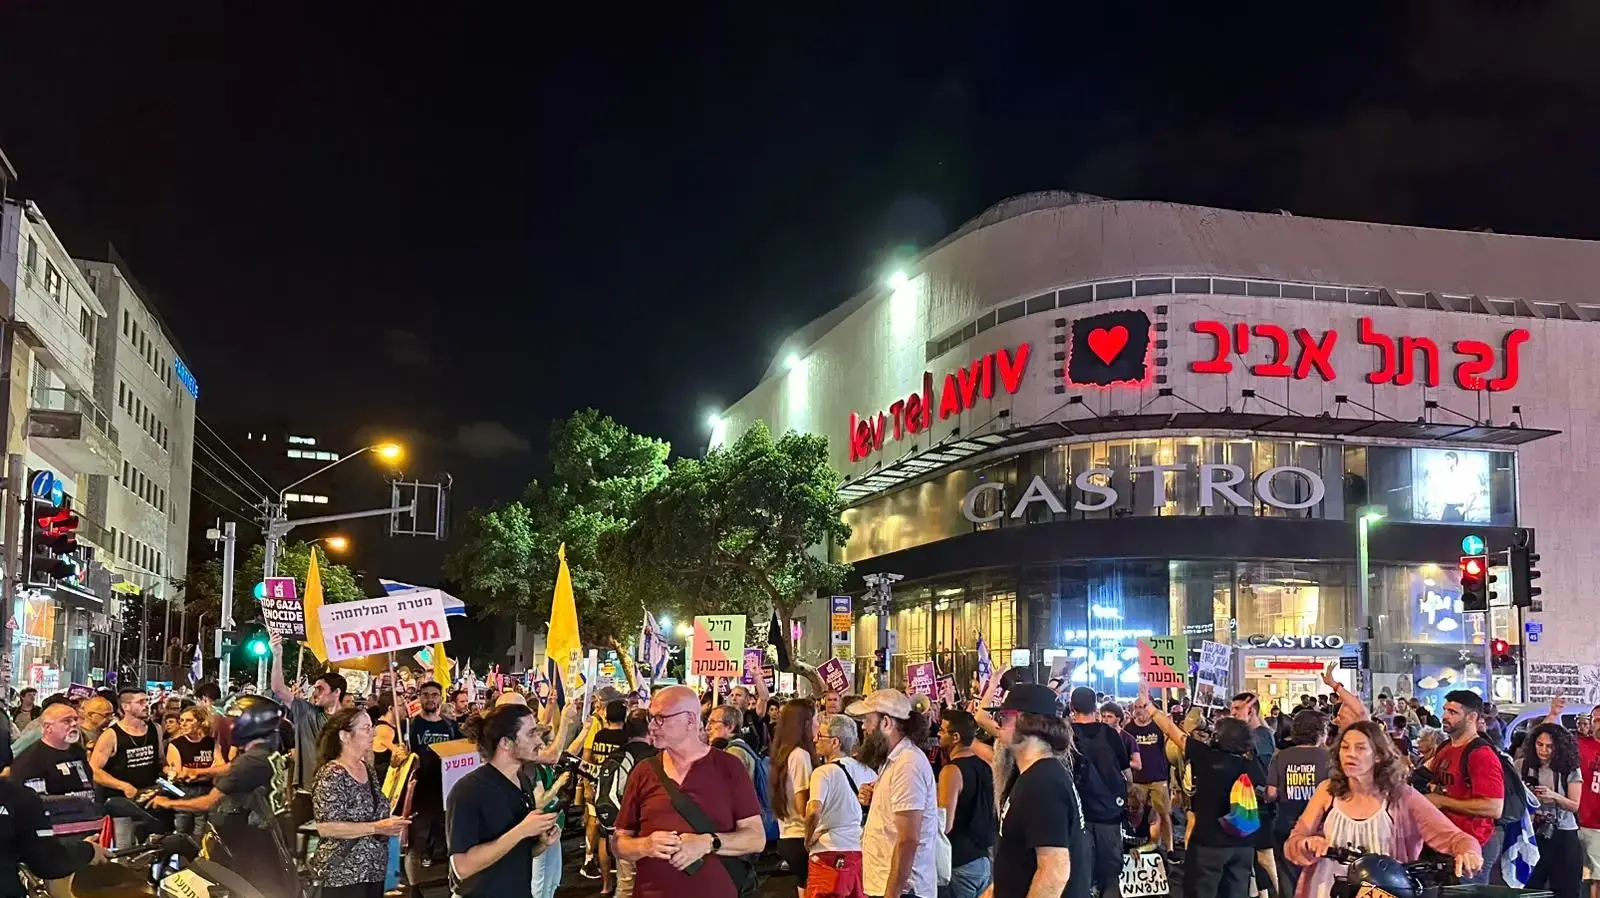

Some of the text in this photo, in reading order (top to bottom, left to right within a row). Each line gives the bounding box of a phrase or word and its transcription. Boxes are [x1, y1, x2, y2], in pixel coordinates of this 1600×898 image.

[1188, 316, 1530, 391] לב תל אביב
[939, 342, 1030, 421] AVIV
[963, 463, 1325, 523] CASTRO
[276, 599, 303, 610] GAZA
[330, 596, 433, 621] מטרת המלחמה:
[708, 617, 732, 631] חייל
[334, 618, 440, 655] מלחמה!
[1150, 637, 1174, 650] חייל
[1248, 633, 1344, 648] CASTRO
[705, 640, 730, 651] סרב
[694, 659, 739, 674] הופעתך
[1150, 655, 1175, 666] סרב
[445, 756, 474, 771] מפשע
[1300, 764, 1315, 773] THEM
[1287, 773, 1315, 786] HOME!
